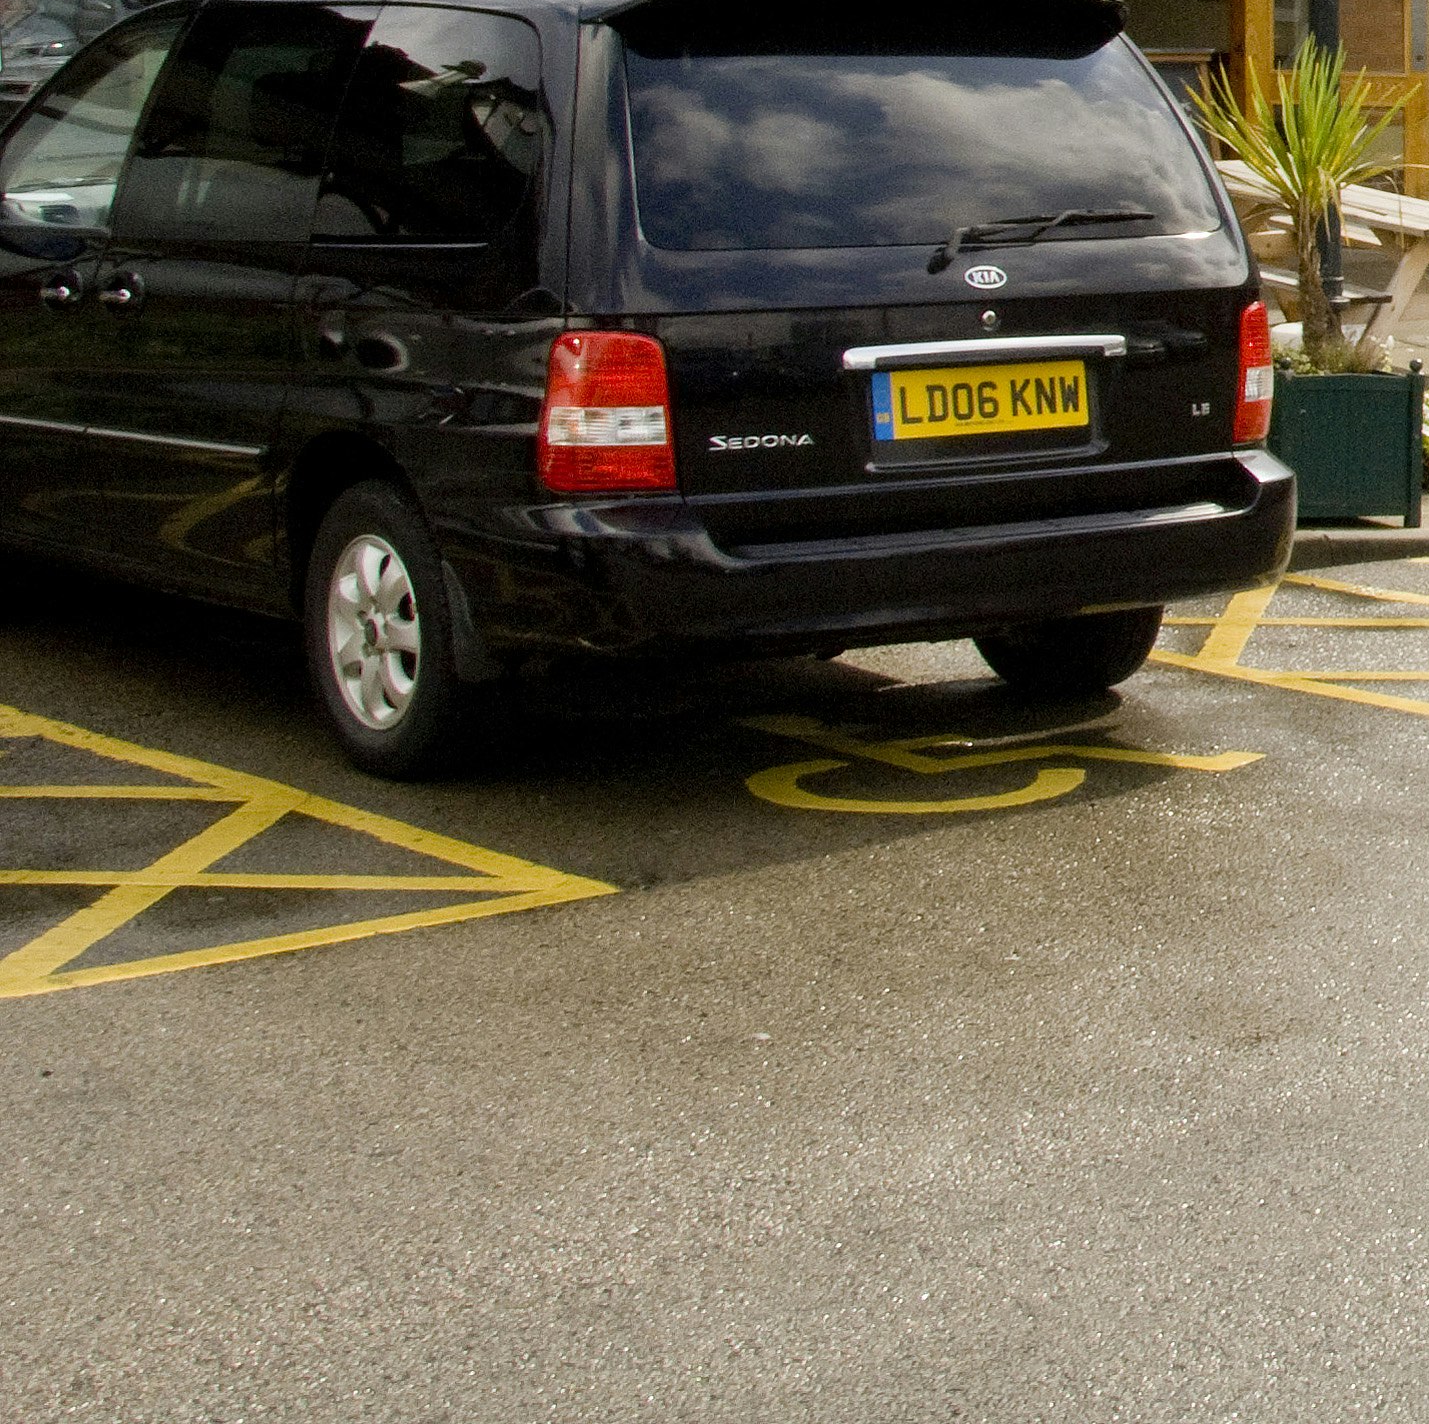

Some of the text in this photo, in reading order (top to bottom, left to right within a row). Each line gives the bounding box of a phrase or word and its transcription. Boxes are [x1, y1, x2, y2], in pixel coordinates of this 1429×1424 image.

[970, 270, 1001, 284] KIA
[900, 376, 1080, 425] LD06 KNW
[708, 434, 815, 451] SEDONA
